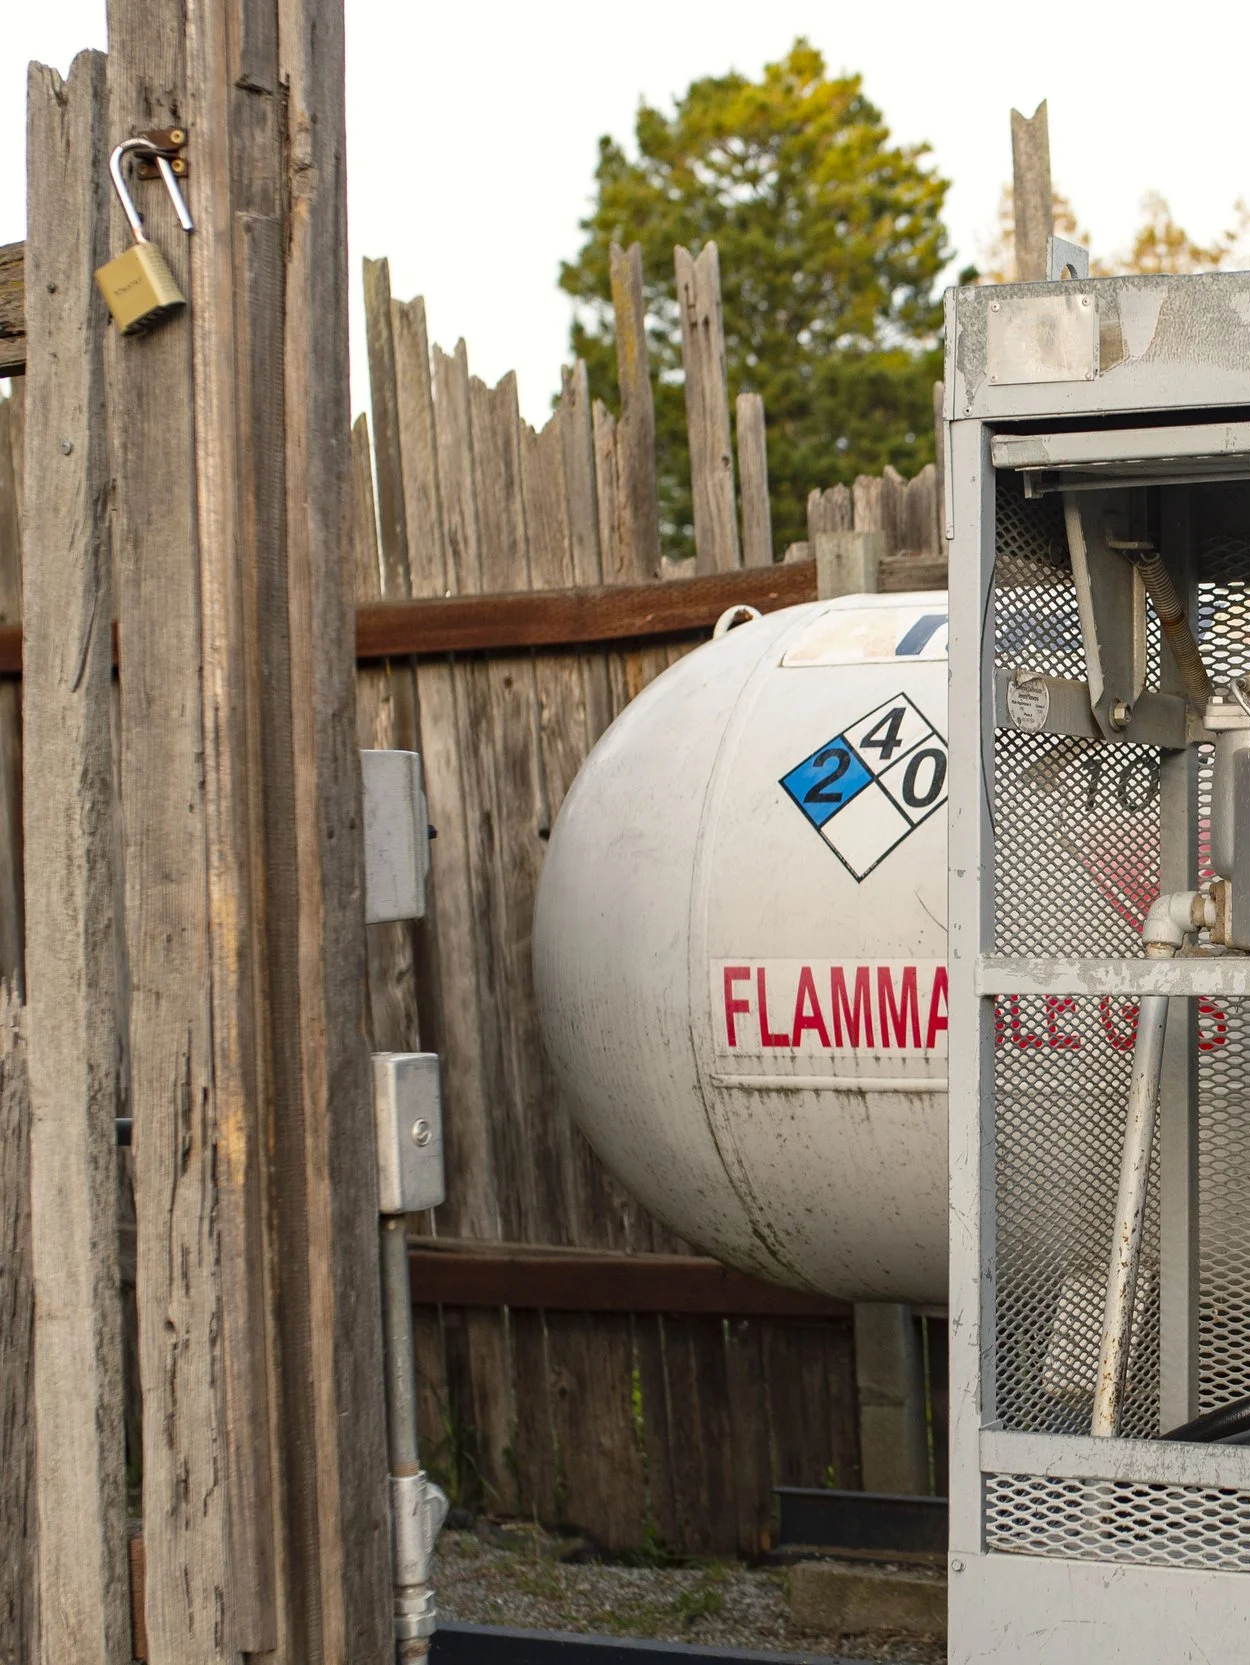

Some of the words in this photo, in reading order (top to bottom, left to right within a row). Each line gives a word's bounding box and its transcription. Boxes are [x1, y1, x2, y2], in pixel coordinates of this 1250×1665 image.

[859, 707, 907, 760] 4
[803, 748, 851, 803] 2
[902, 748, 947, 808] 0
